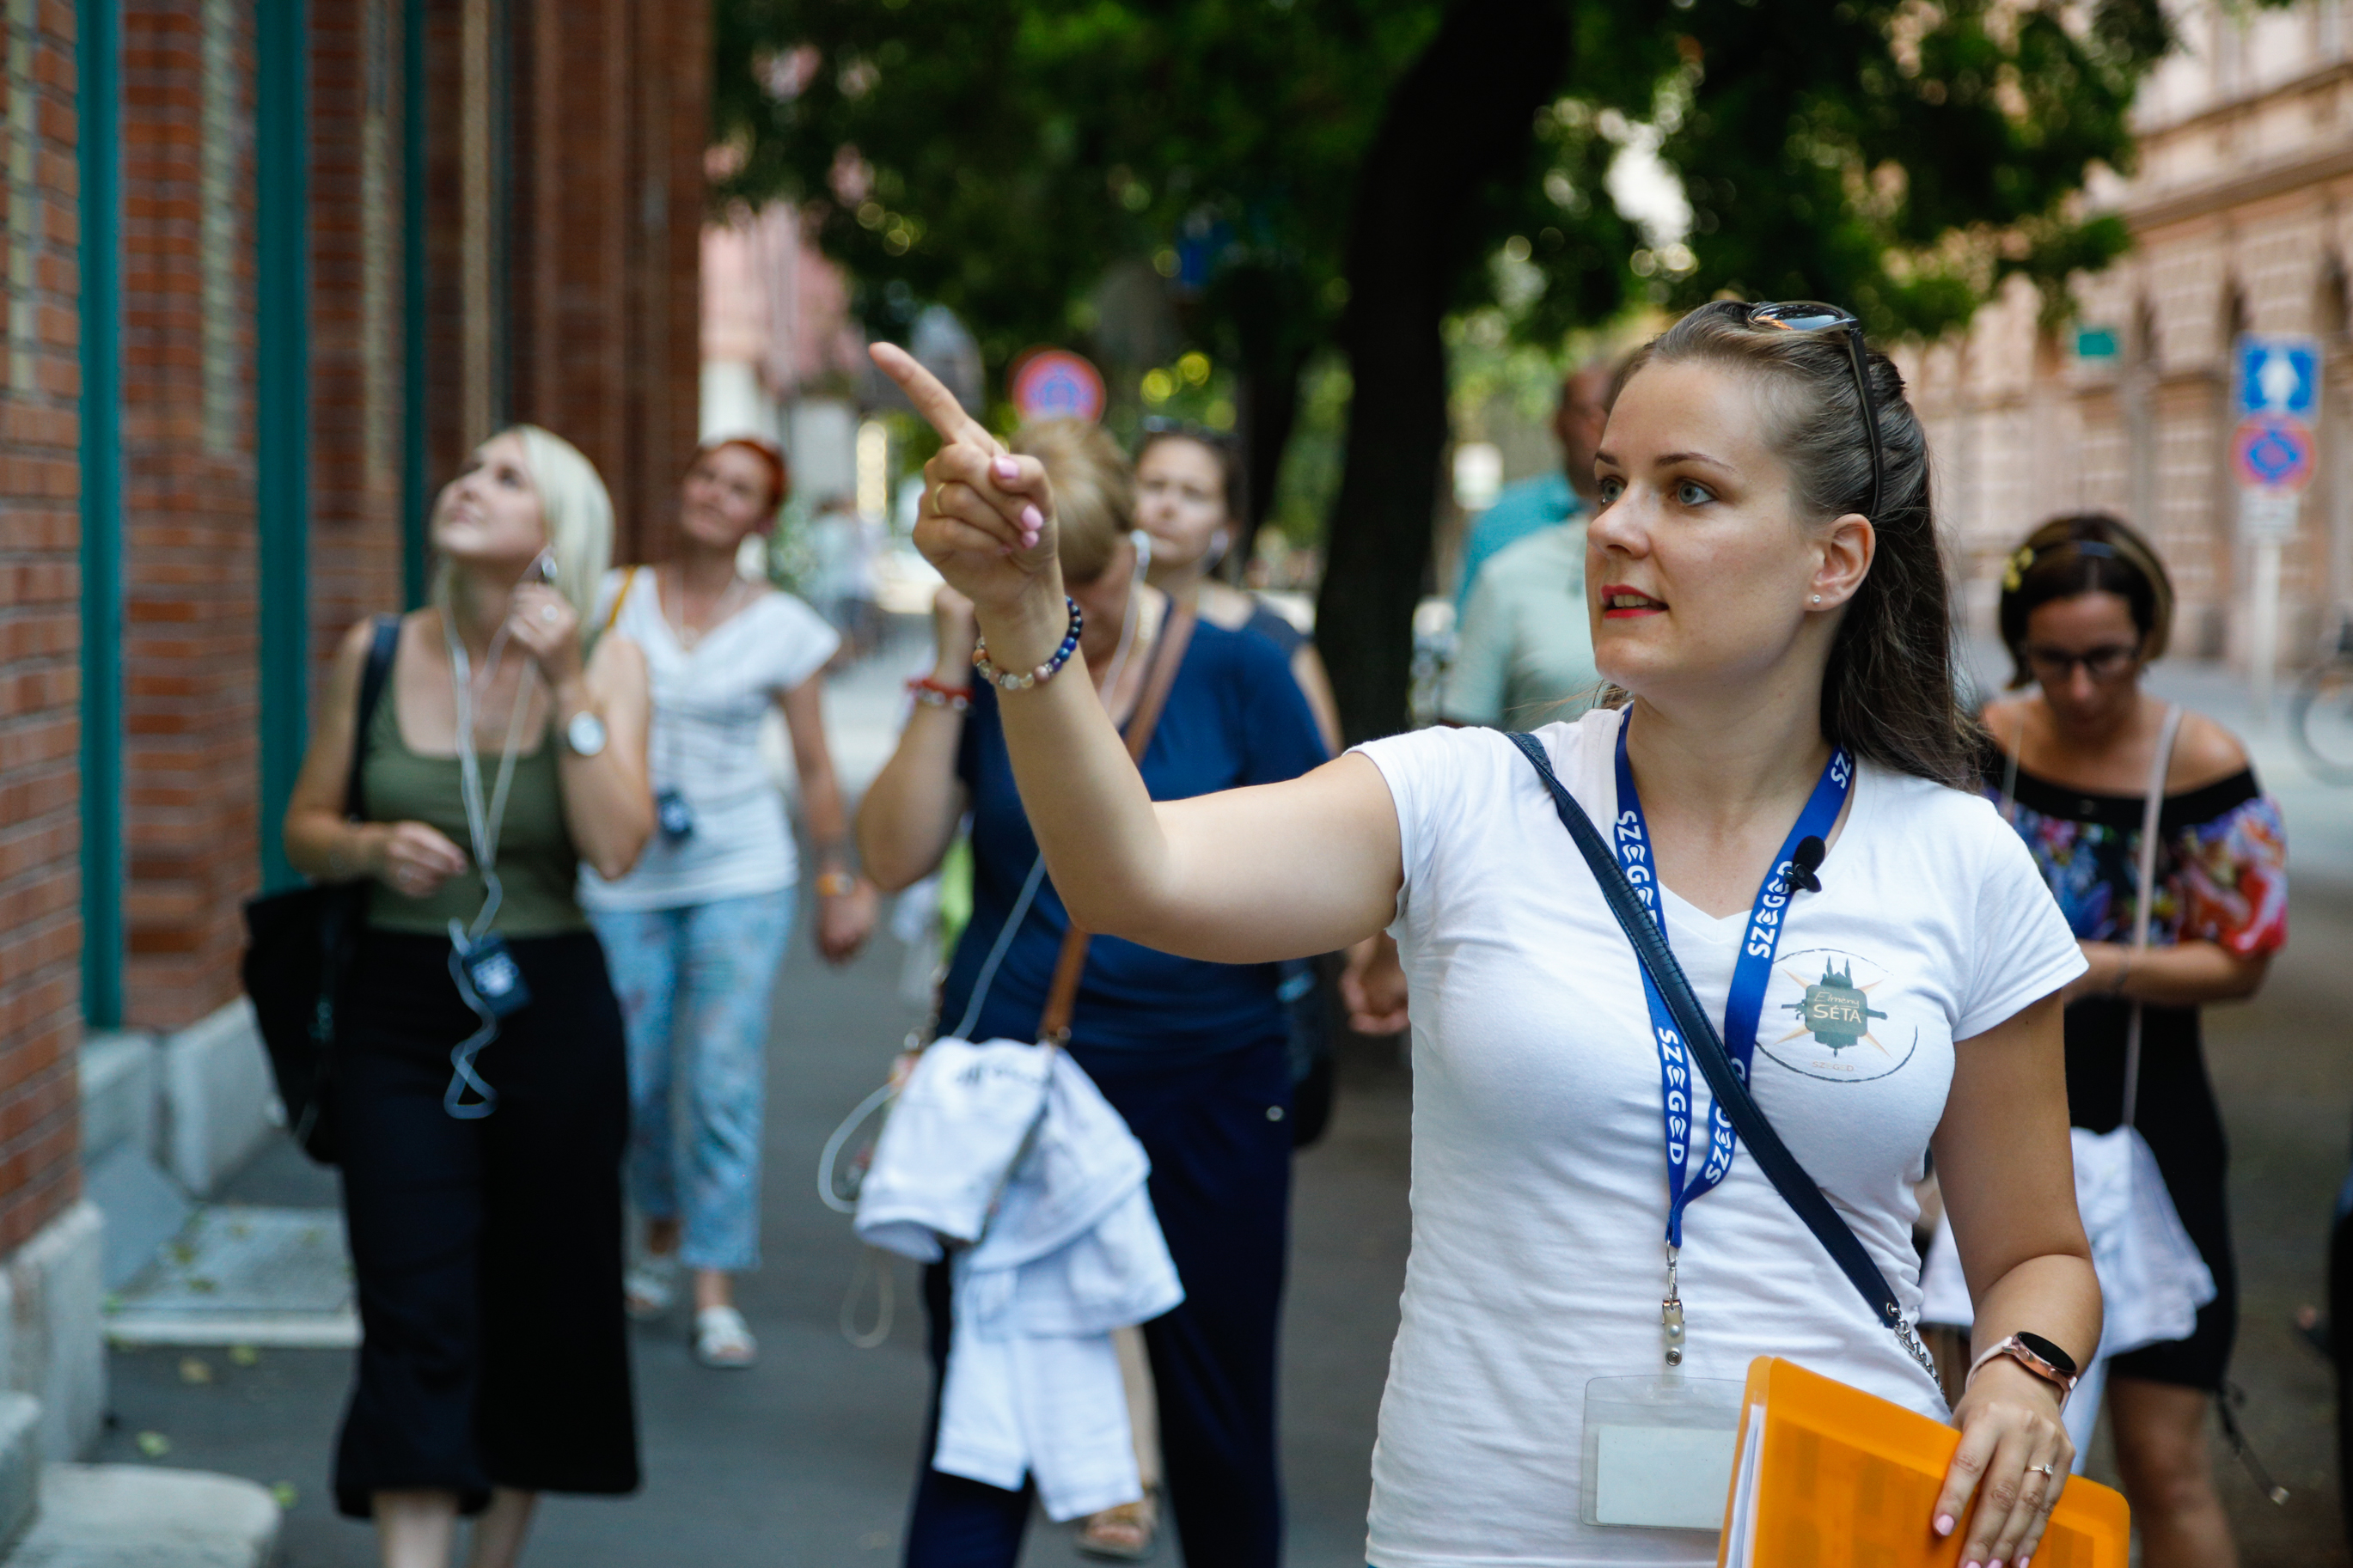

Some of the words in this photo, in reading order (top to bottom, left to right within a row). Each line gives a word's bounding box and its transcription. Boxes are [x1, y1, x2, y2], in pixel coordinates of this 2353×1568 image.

[1830, 741, 1852, 789] SZ
[1813, 1004, 1861, 1024] SÉTA
[1659, 1027, 1687, 1165] SZEGED
